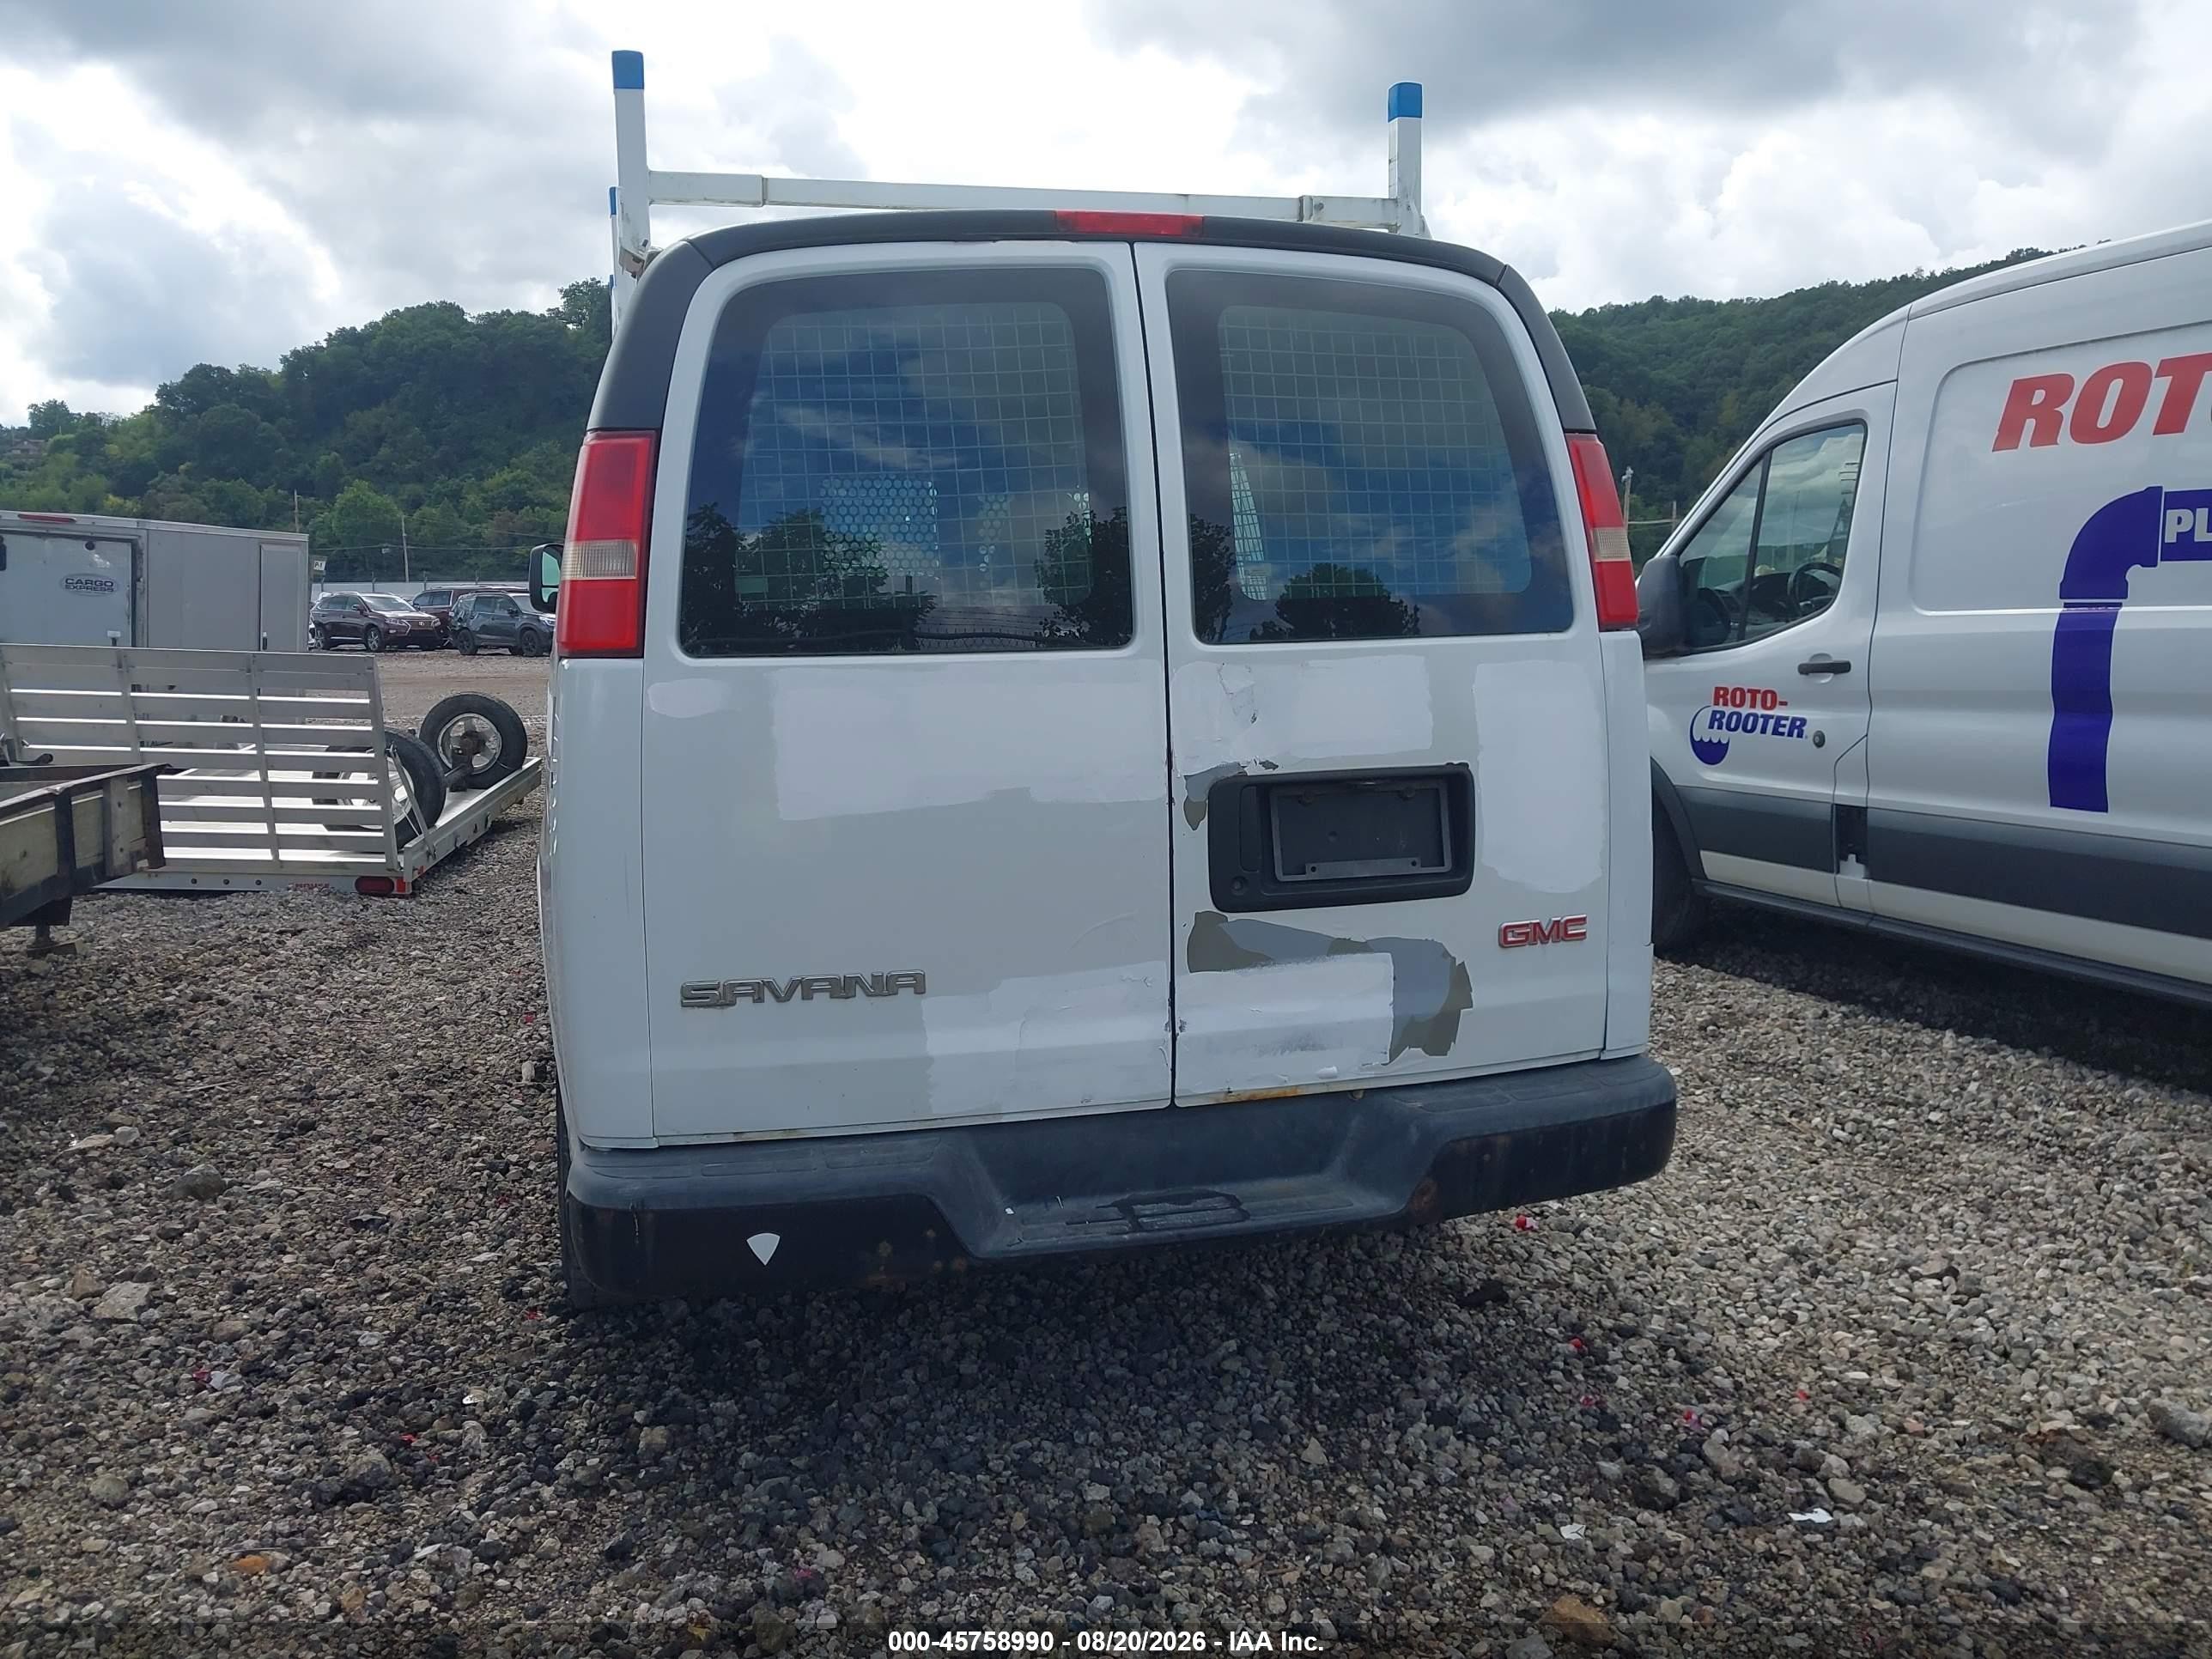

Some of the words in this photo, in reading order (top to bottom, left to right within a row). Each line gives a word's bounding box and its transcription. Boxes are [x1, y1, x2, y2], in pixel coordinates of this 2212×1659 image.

[65, 578, 114, 587] CARGO
[65, 584, 114, 592] EXPRESS
[1713, 686, 1788, 711] ROTO-
[1708, 709, 1807, 738] ROOTER
[1498, 915, 1587, 947] GMC
[681, 969, 926, 1008] SAVANA
